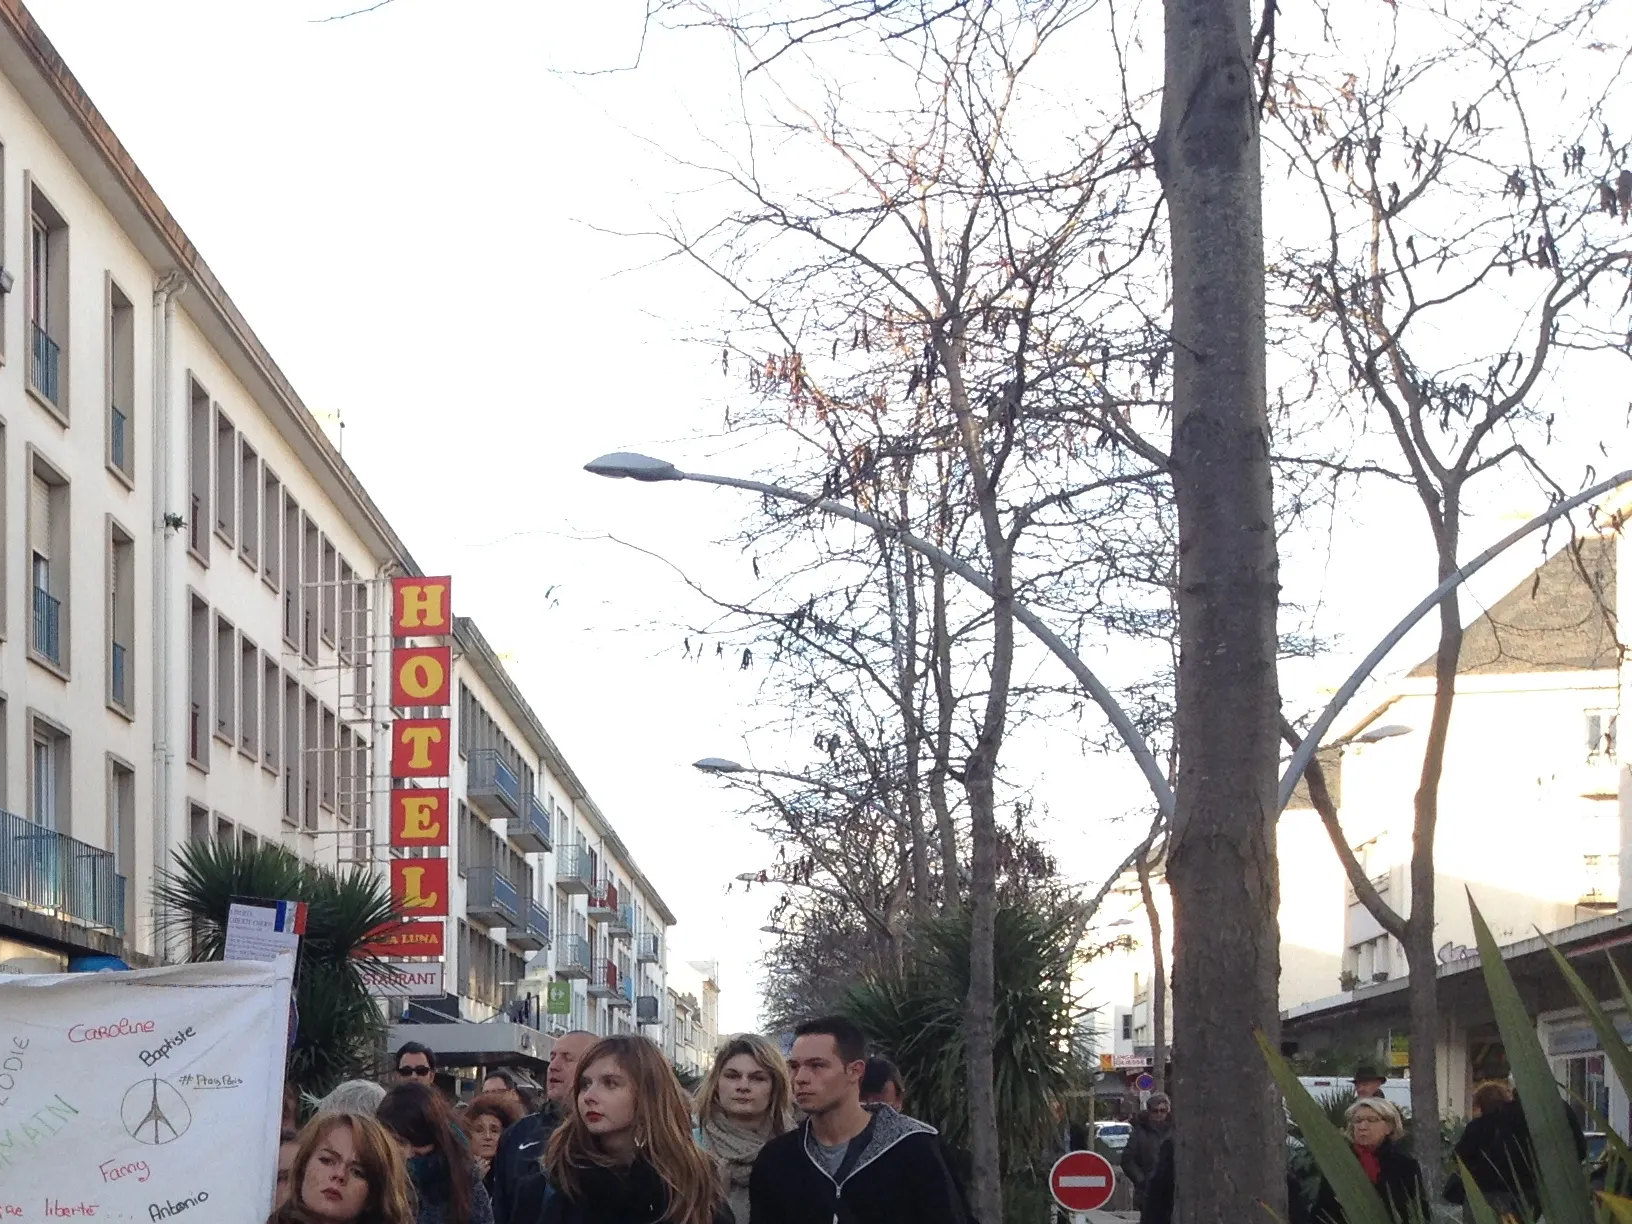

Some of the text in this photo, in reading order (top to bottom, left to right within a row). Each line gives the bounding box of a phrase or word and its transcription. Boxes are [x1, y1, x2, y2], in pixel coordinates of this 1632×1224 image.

[399, 584, 446, 908] HOTEL
[402, 934, 438, 944] LUNA
[68, 1017, 155, 1043] Caroline
[139, 1026, 196, 1067] Baptiste
[99, 1158, 150, 1183] Fanny
[148, 1191, 209, 1223] Antonio
